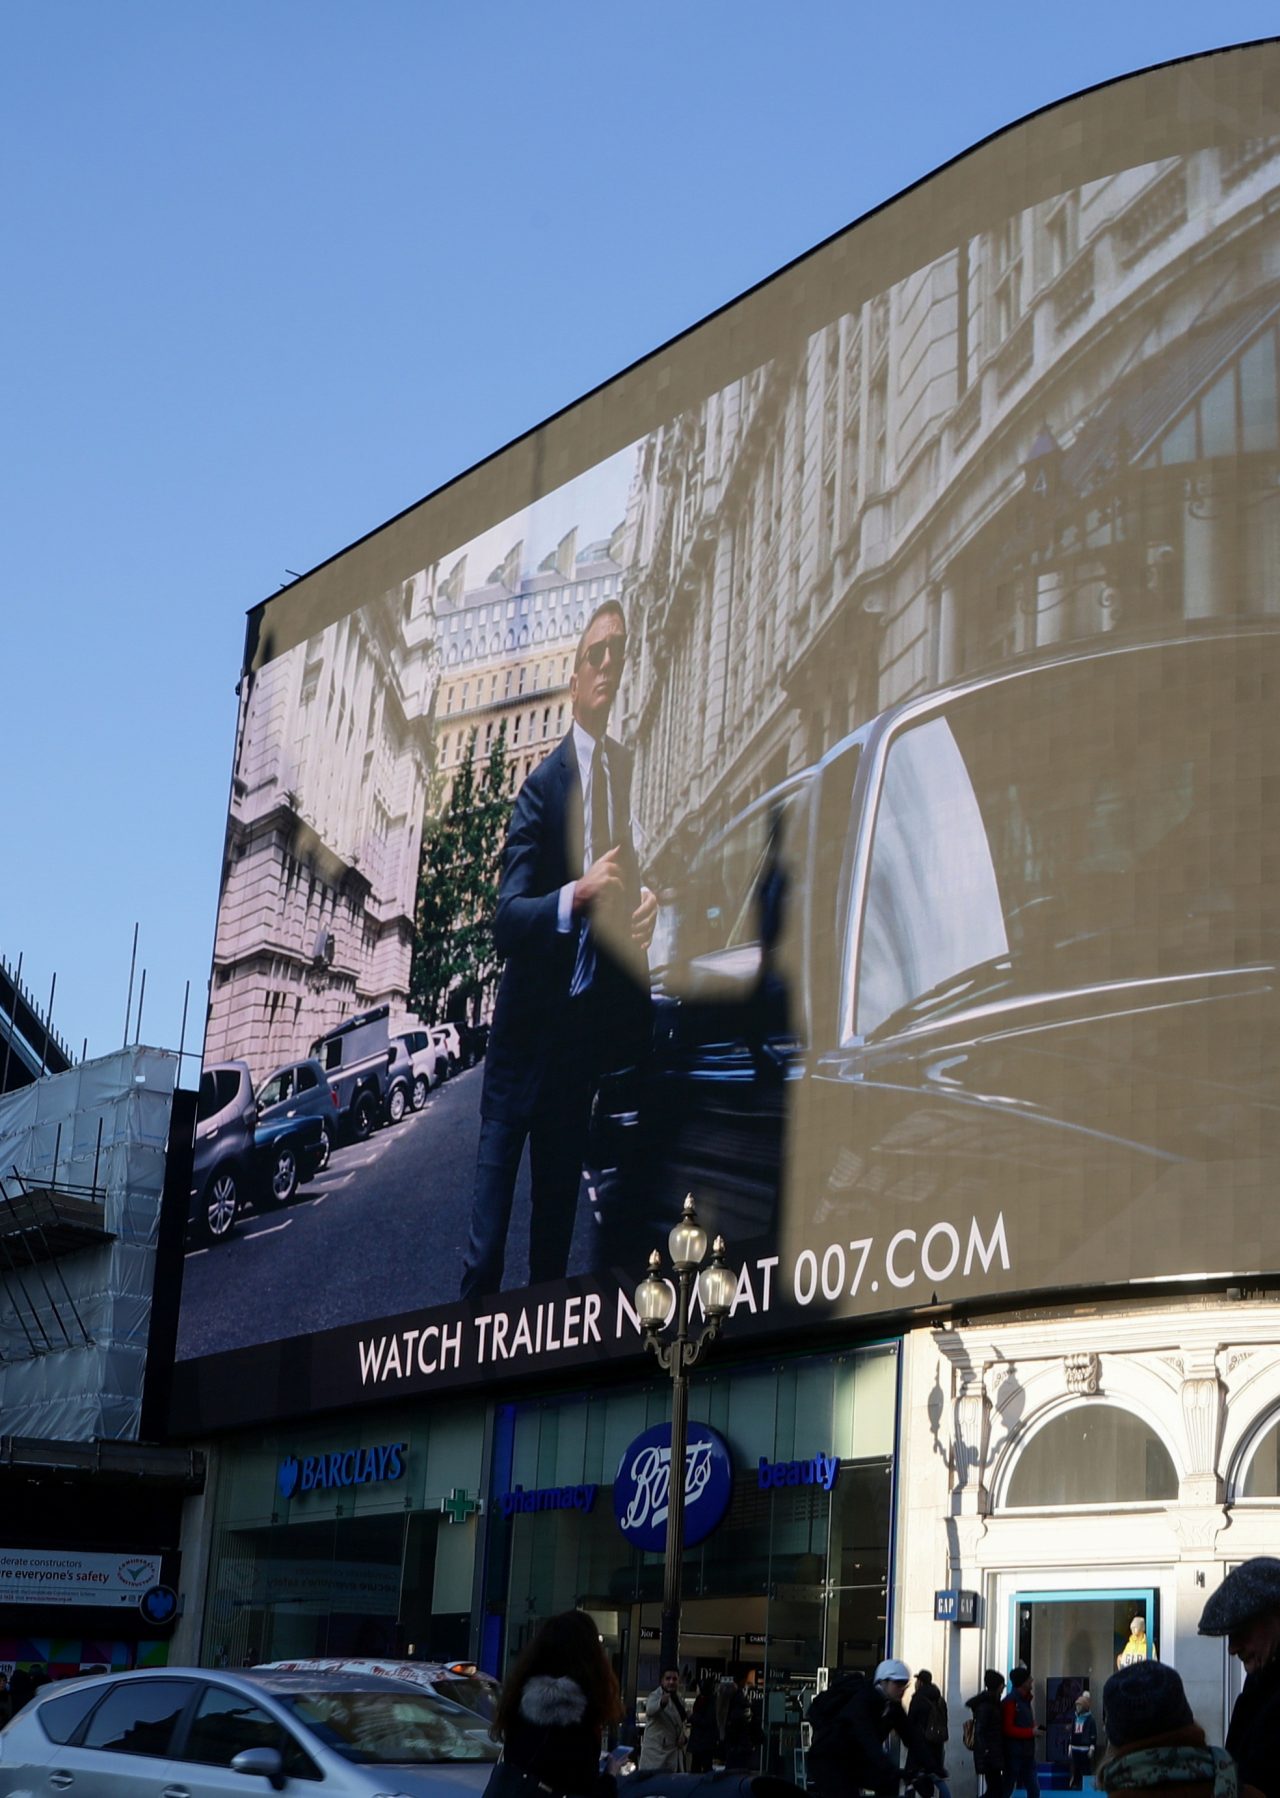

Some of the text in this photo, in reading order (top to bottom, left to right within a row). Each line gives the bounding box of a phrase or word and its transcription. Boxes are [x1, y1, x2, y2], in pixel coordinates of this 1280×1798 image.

[358, 1320, 462, 1386] WATCH
[474, 1293, 603, 1362] TRAILER
[727, 1255, 780, 1319] AT
[794, 1210, 1012, 1306] 007.COM
[300, 1442, 408, 1491] BARCLAYS
[757, 1450, 841, 1491] beauty
[500, 1484, 598, 1519] pharmacy
[621, 1440, 713, 1530] Bots
[15, 1569, 73, 1583] everyone's
[76, 1571, 109, 1584] safety
[29, 1558, 82, 1568] constructors
[938, 1597, 954, 1614] GAP
[960, 1598, 974, 1614] GAP
